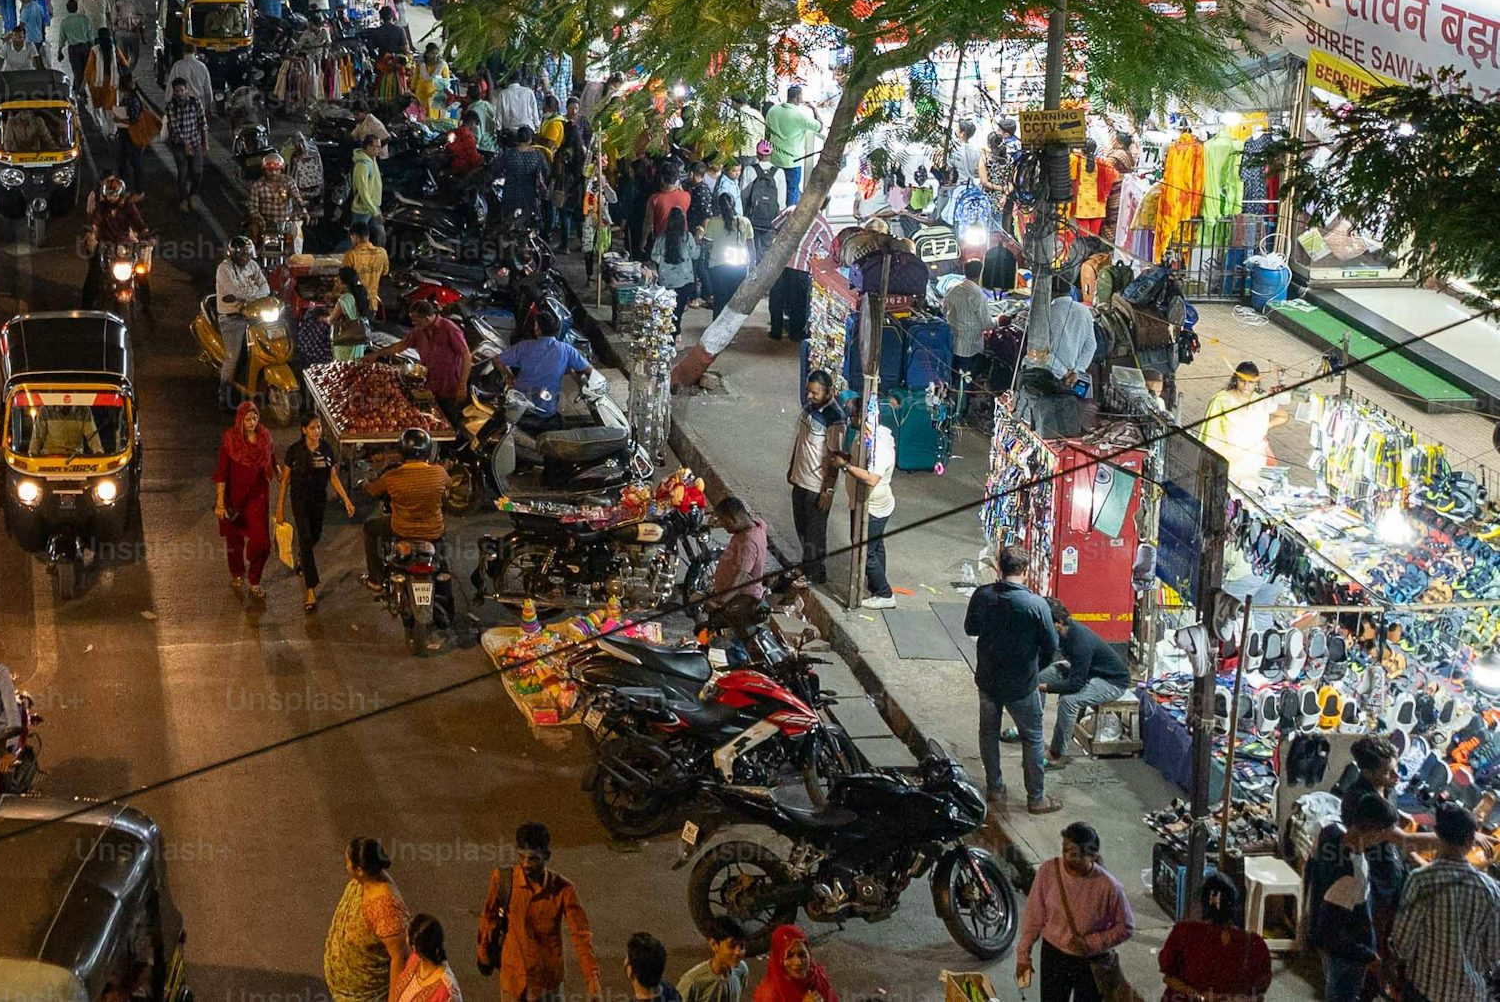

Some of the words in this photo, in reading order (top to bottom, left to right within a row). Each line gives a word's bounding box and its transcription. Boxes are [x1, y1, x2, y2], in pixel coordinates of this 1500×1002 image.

[1306, 19, 1366, 65] SHREE
[1023, 112, 1077, 121] WARNING
[1024, 122, 1056, 133] CCTV
